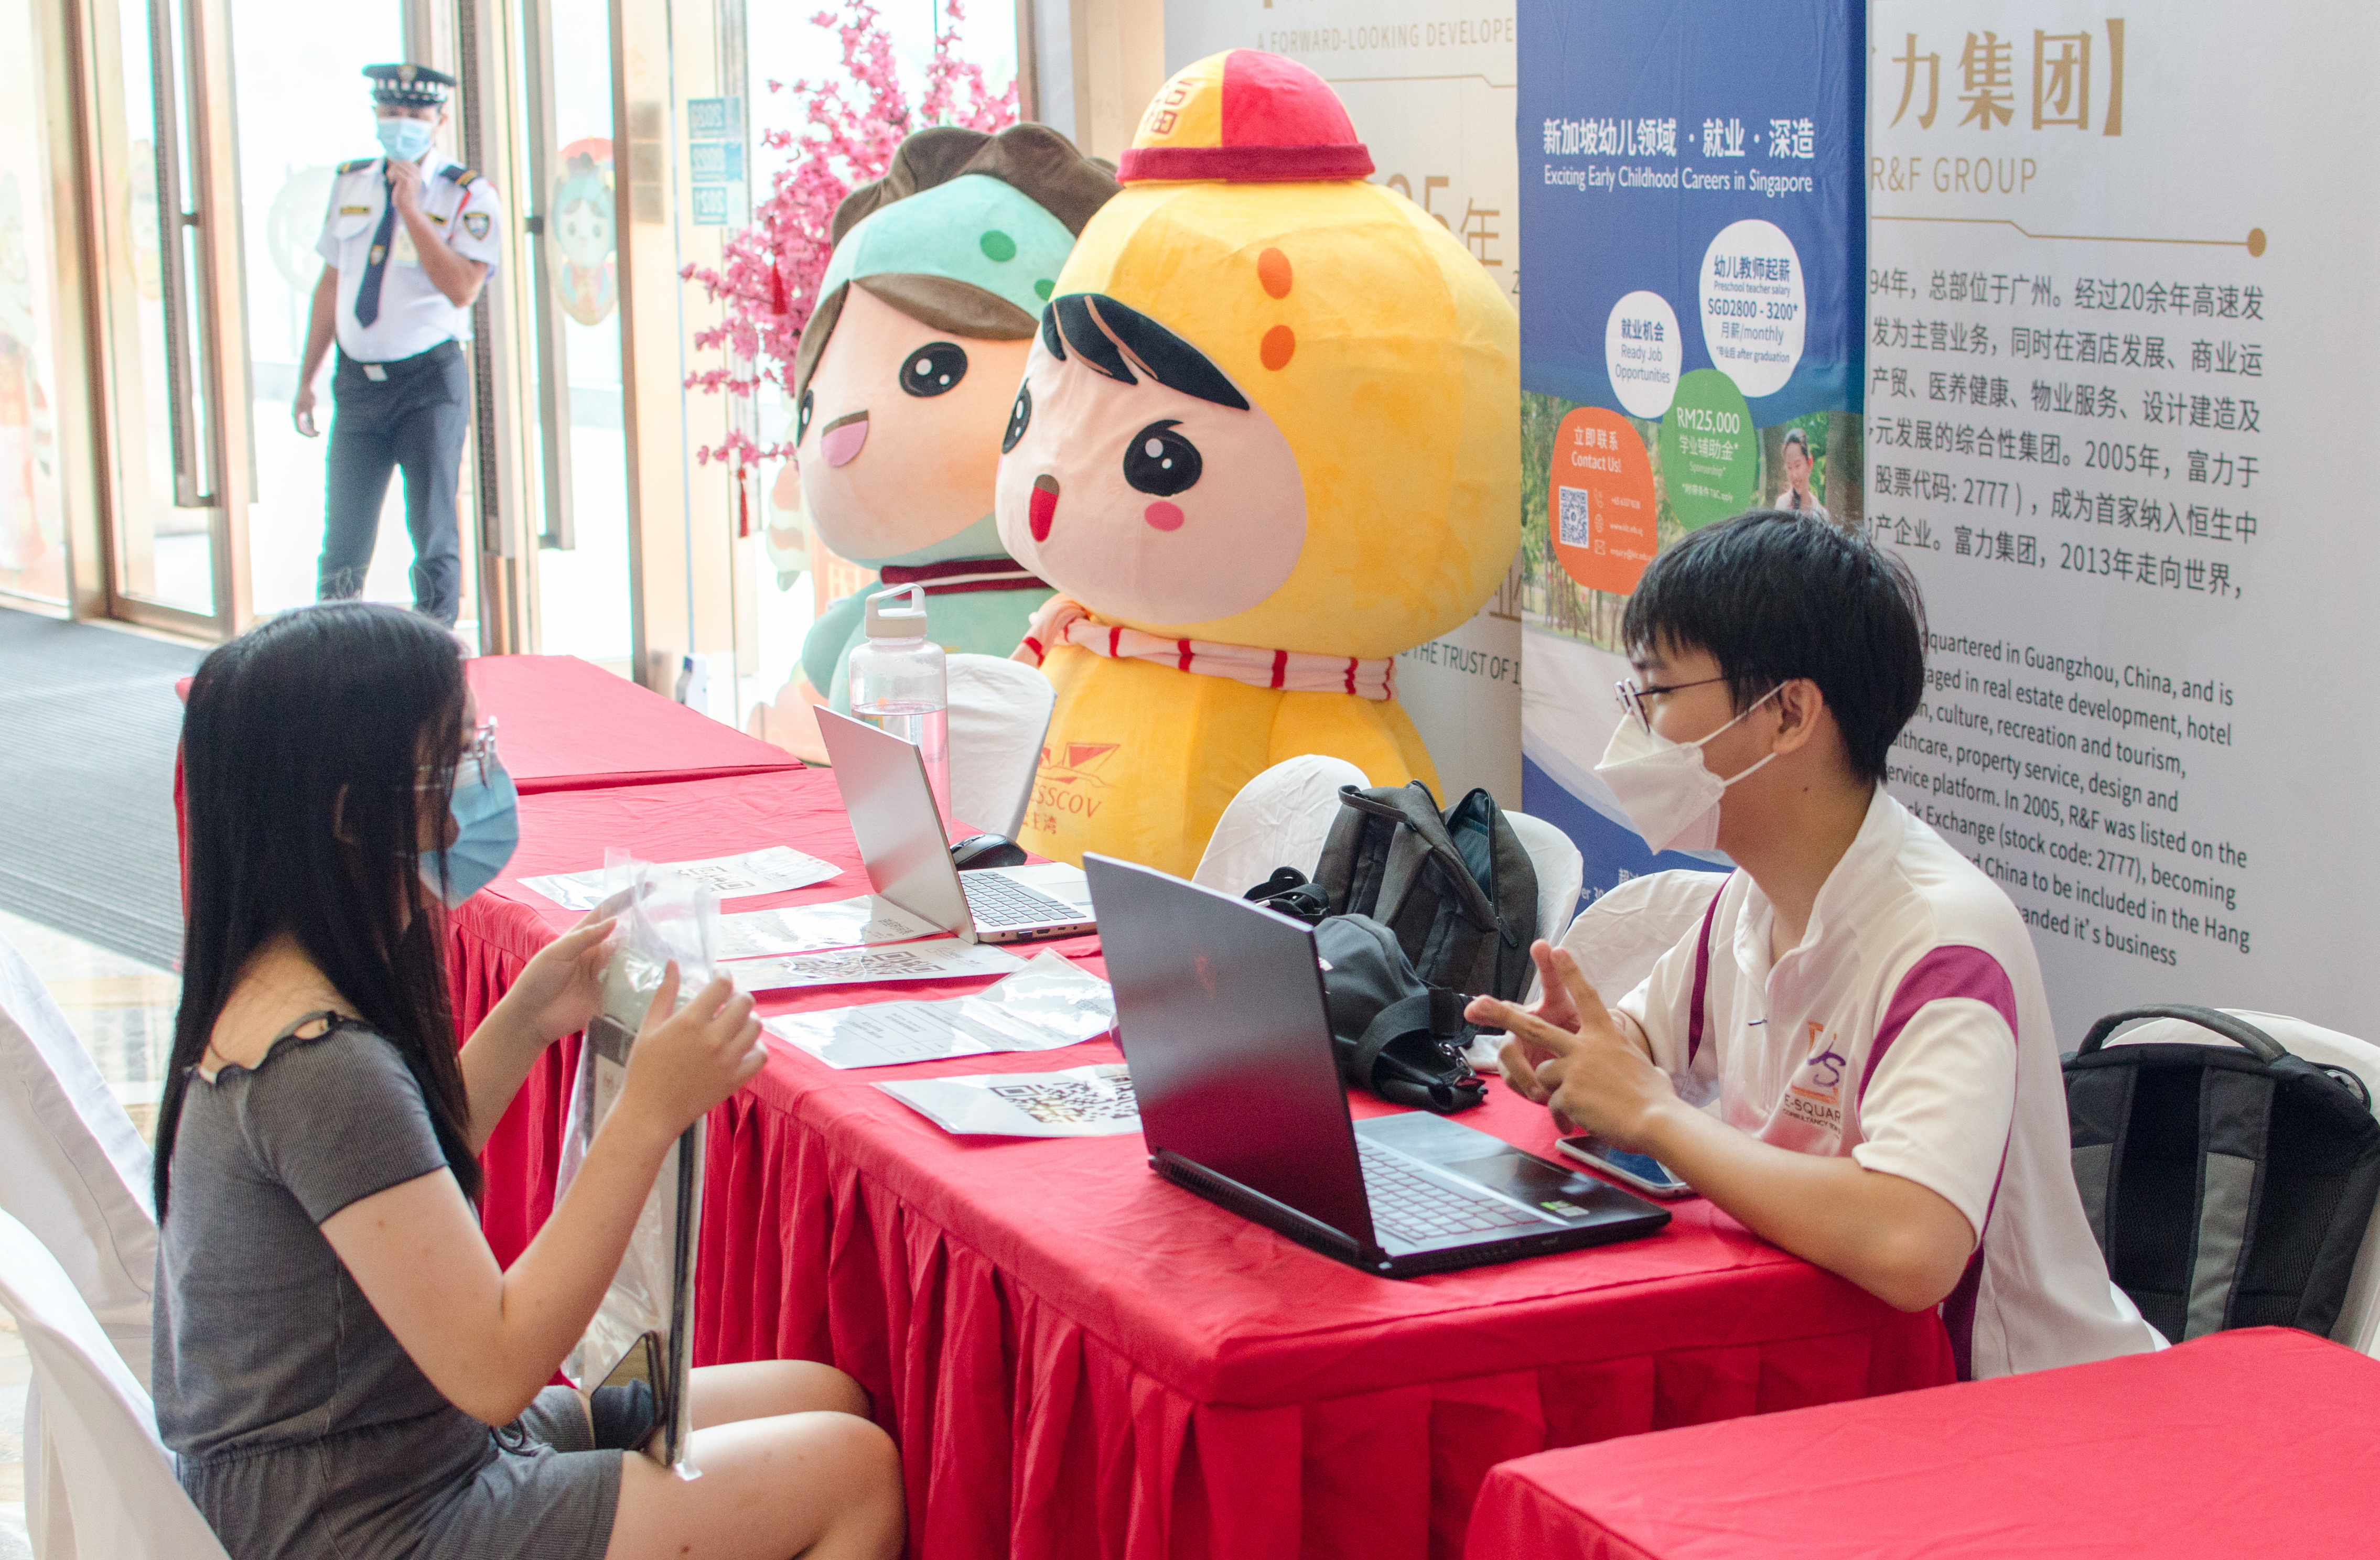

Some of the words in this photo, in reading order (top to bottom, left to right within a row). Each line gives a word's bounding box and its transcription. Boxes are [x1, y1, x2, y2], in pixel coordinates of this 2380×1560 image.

[1270, 23, 1419, 53] FORWARD-LOOKING
[1426, 17, 1514, 47] DEVELOPE
[1871, 18, 2125, 137] 力集团】
[1543, 118, 1677, 157] 新加坡幼儿领域
[1703, 118, 1746, 158] 就业
[1769, 118, 1815, 159] 深造
[1544, 165, 1586, 192] Exciting
[1588, 166, 1616, 192] Early
[1618, 166, 1678, 189] Childhood
[1682, 168, 1730, 190] Careers
[1734, 170, 1746, 191] in
[1749, 168, 1813, 198] Singapore
[1871, 156, 1922, 192] R&F
[1933, 157, 2037, 194] GROUP
[1714, 254, 1791, 282] 幼儿教师起薪
[1714, 280, 1745, 292] Preschool
[1746, 283, 1771, 294] teacher
[1772, 283, 1791, 298] salary
[1708, 297, 1757, 318] SGD2800
[1621, 318, 1664, 342] 就业机会
[1721, 321, 1784, 346] 月薪/monthly
[1621, 344, 1646, 364] Ready
[1648, 346, 1662, 362] Job
[1737, 348, 1753, 360] after
[1754, 350, 1790, 363] graduation
[1615, 363, 1671, 384] Opportunities
[1574, 426, 1619, 451] 立即联系
[1677, 406, 1740, 435] RM25,000
[1571, 450, 1606, 471] Contact
[1608, 457, 1622, 473] Us!
[1869, 417, 2259, 489] 元发展的综合性集团。2005年，富力于
[1442, 643, 1488, 675] TRUST
[1490, 656, 1510, 680] OF
[1929, 632, 2002, 662] quartered
[2007, 642, 2020, 665] in
[2026, 646, 2119, 688] Guangzhou,
[2124, 665, 2177, 700] China,
[2181, 679, 2213, 702] and
[2219, 682, 2234, 707] is
[1923, 668, 1961, 691] aged
[1966, 670, 1979, 693] in
[1984, 678, 2012, 700] real
[2016, 687, 2064, 711] estate
[2068, 692, 2182, 740] development,
[2187, 715, 2232, 746] hotel
[1936, 703, 1993, 736] culture,
[1997, 718, 2076, 751] recreation
[2081, 734, 2112, 759] and
[2116, 742, 2186, 780] tourism,
[1956, 745, 2021, 780] property
[2024, 761, 2084, 794] service,
[2088, 772, 2142, 807] design
[2147, 790, 2179, 812] and
[1933, 772, 2000, 807] platform.
[2005, 789, 2019, 812] In
[2023, 794, 2065, 827] 2005,
[2069, 805, 2099, 831] R&F
[2104, 816, 2136, 841] was
[2140, 821, 2187, 853] listed
[2191, 840, 2213, 858] on
[2218, 841, 2248, 869] the
[1926, 805, 1995, 845] Exchange
[1999, 822, 2045, 855] (stock
[2049, 841, 2092, 868] code:
[2097, 848, 2146, 886] 2777),
[2151, 861, 2236, 911] becoming
[1985, 857, 2028, 886] China
[2032, 870, 2049, 892] to
[2053, 873, 2072, 900] be
[2075, 880, 2146, 920] included
[2151, 900, 2167, 924] in
[2171, 908, 2200, 935] the
[2204, 916, 2250, 954] Hang
[2017, 905, 2070, 936] anded
[2105, 926, 2177, 967] business
